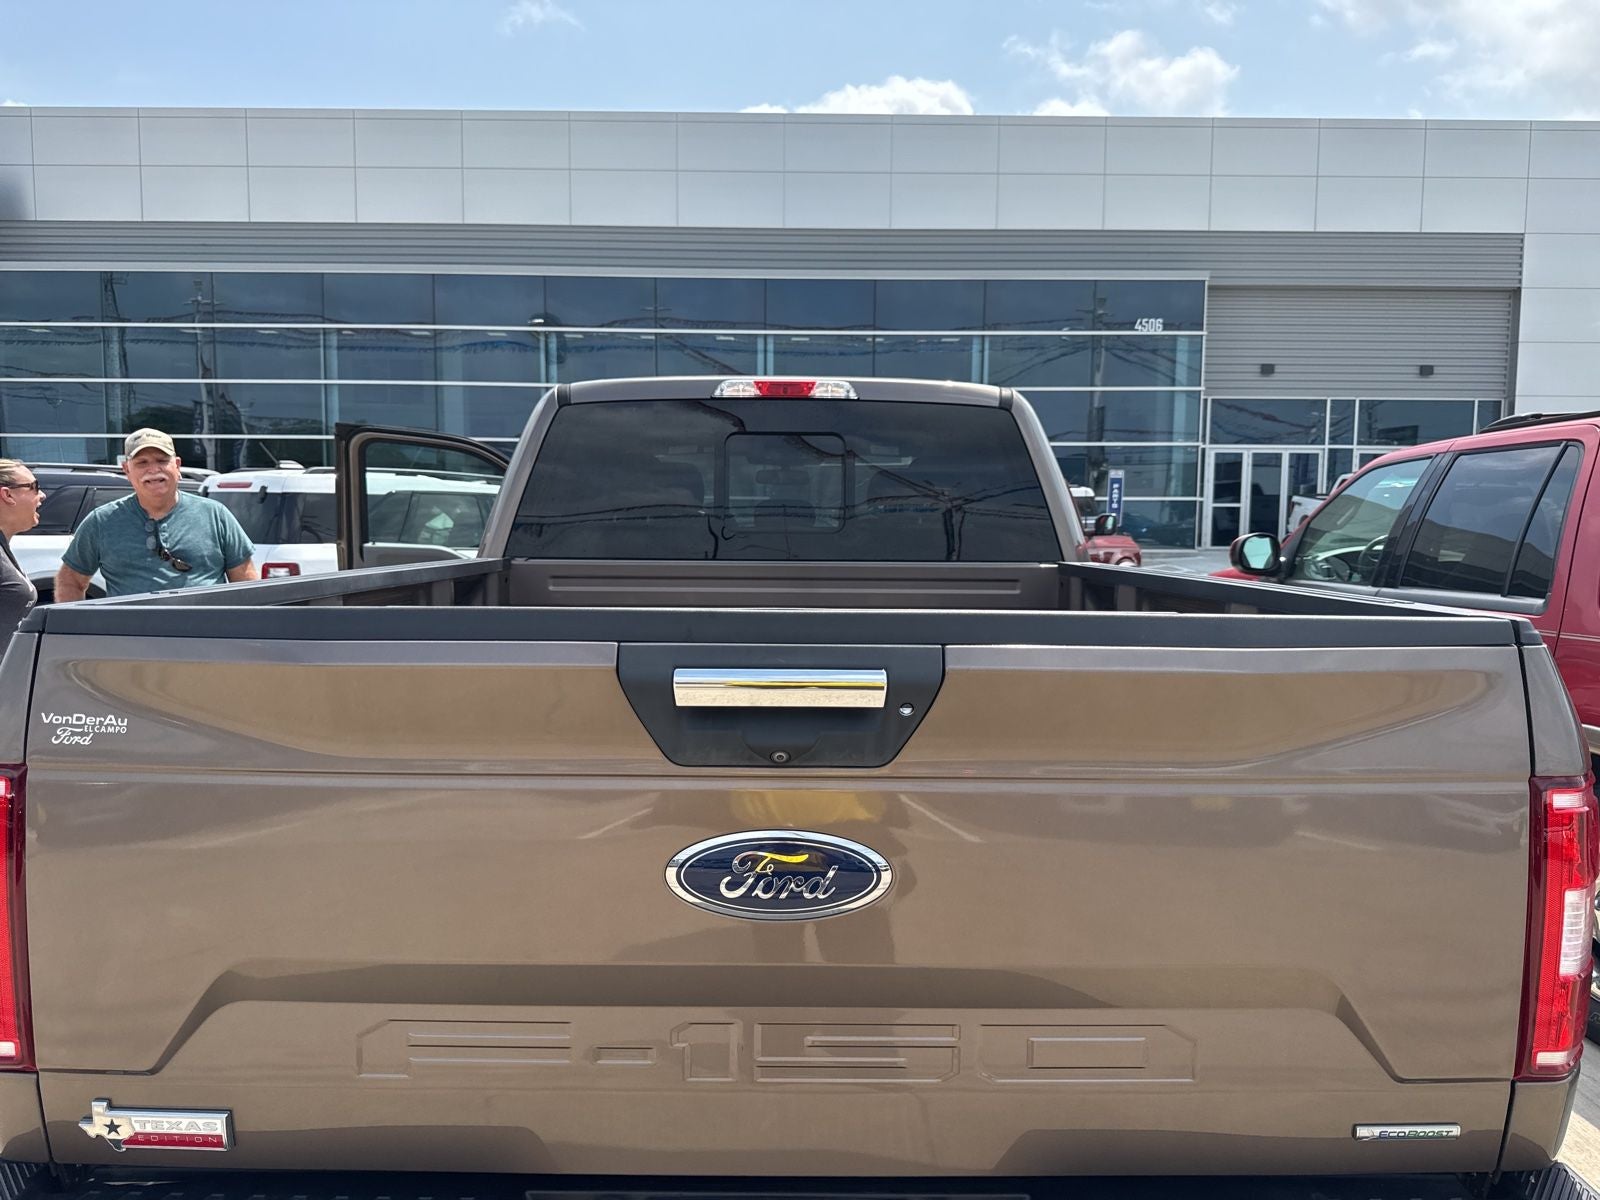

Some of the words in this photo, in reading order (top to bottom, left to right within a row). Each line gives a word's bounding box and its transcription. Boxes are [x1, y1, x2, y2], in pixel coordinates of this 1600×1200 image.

[1134, 318, 1164, 332] 4506
[41, 712, 128, 726] VonDerAu
[51, 727, 93, 745] Ford
[94, 725, 127, 733] CAMPO
[719, 850, 839, 900] Ford
[356, 1018, 1198, 1084] F-150
[134, 1119, 218, 1132] TEXAS
[137, 1135, 218, 1143] EDITION
